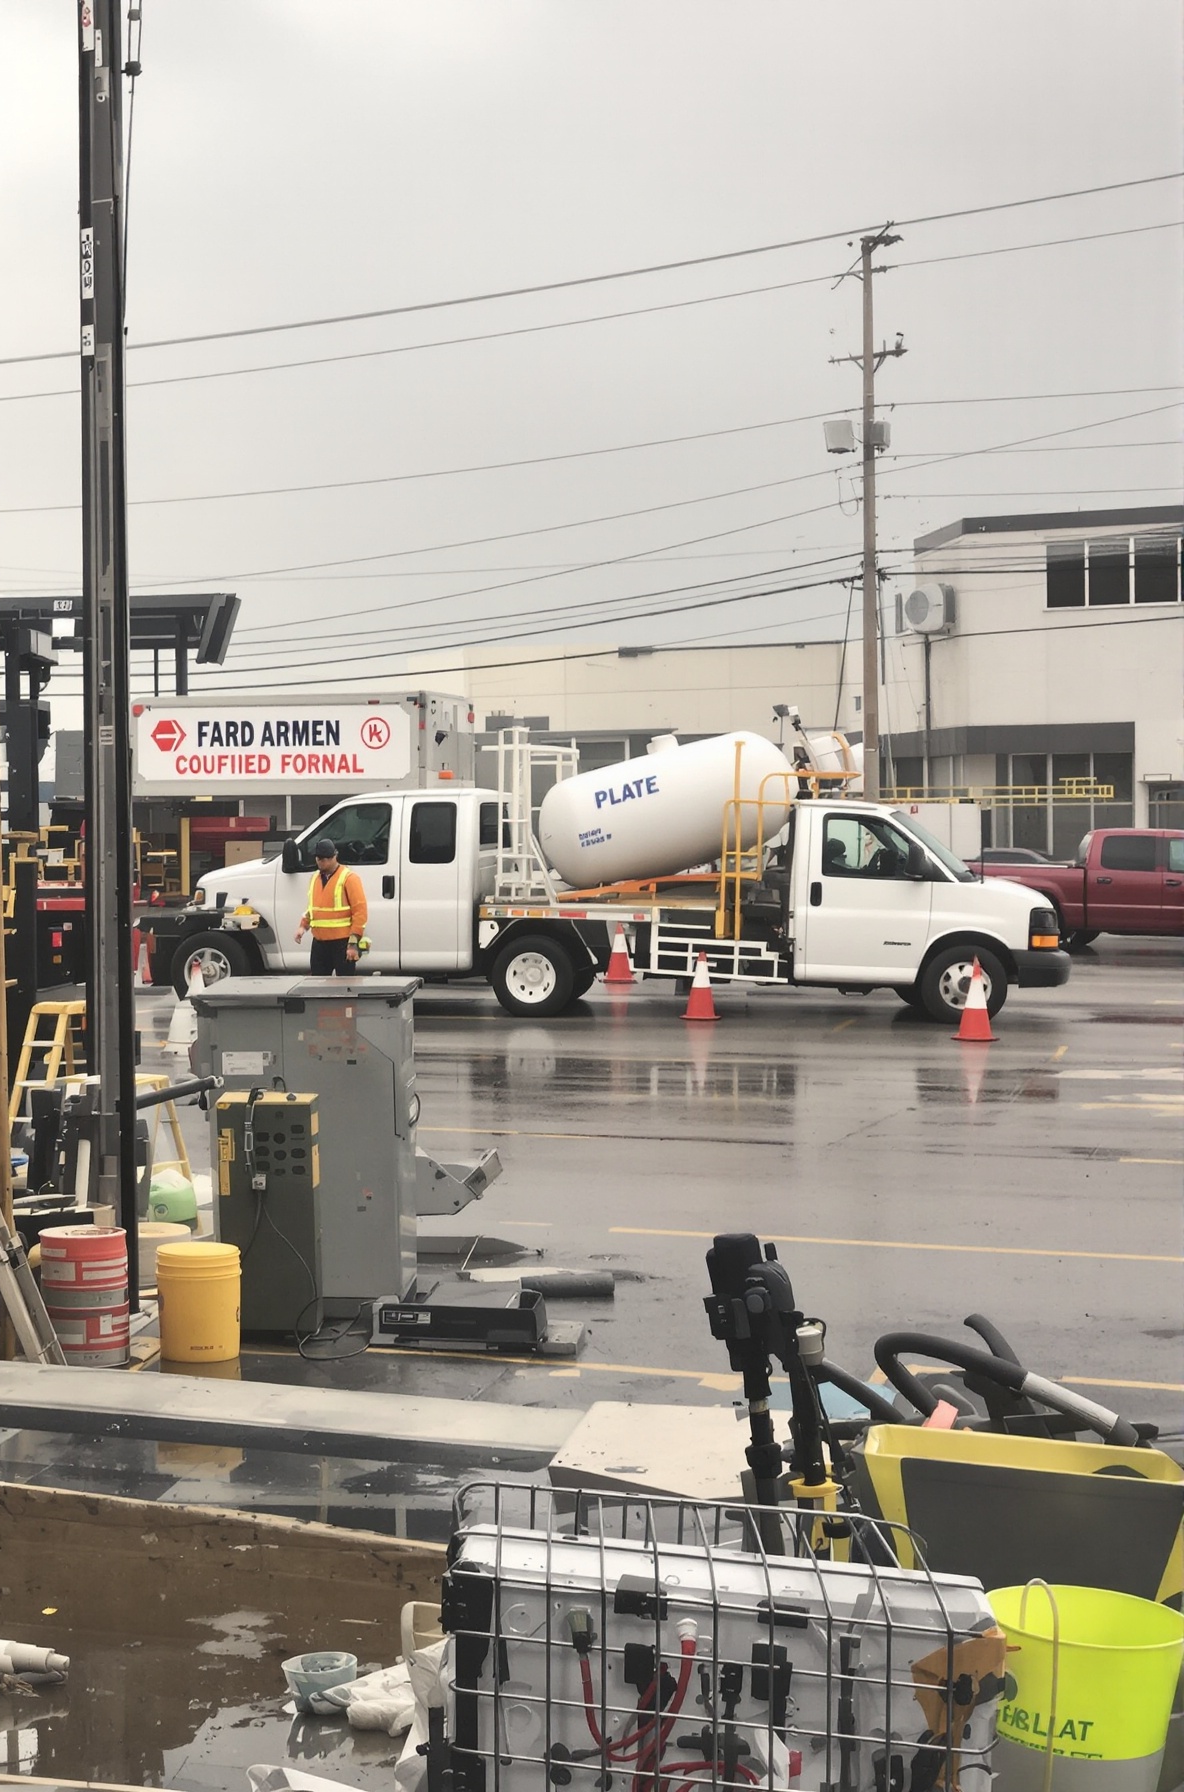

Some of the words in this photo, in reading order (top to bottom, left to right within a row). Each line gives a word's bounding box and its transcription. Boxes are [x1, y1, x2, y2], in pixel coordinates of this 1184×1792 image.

[197, 720, 255, 747] FARD
[260, 720, 340, 747] ARMEN
[281, 753, 365, 774] FORNAL
[594, 775, 660, 809] PLATE
